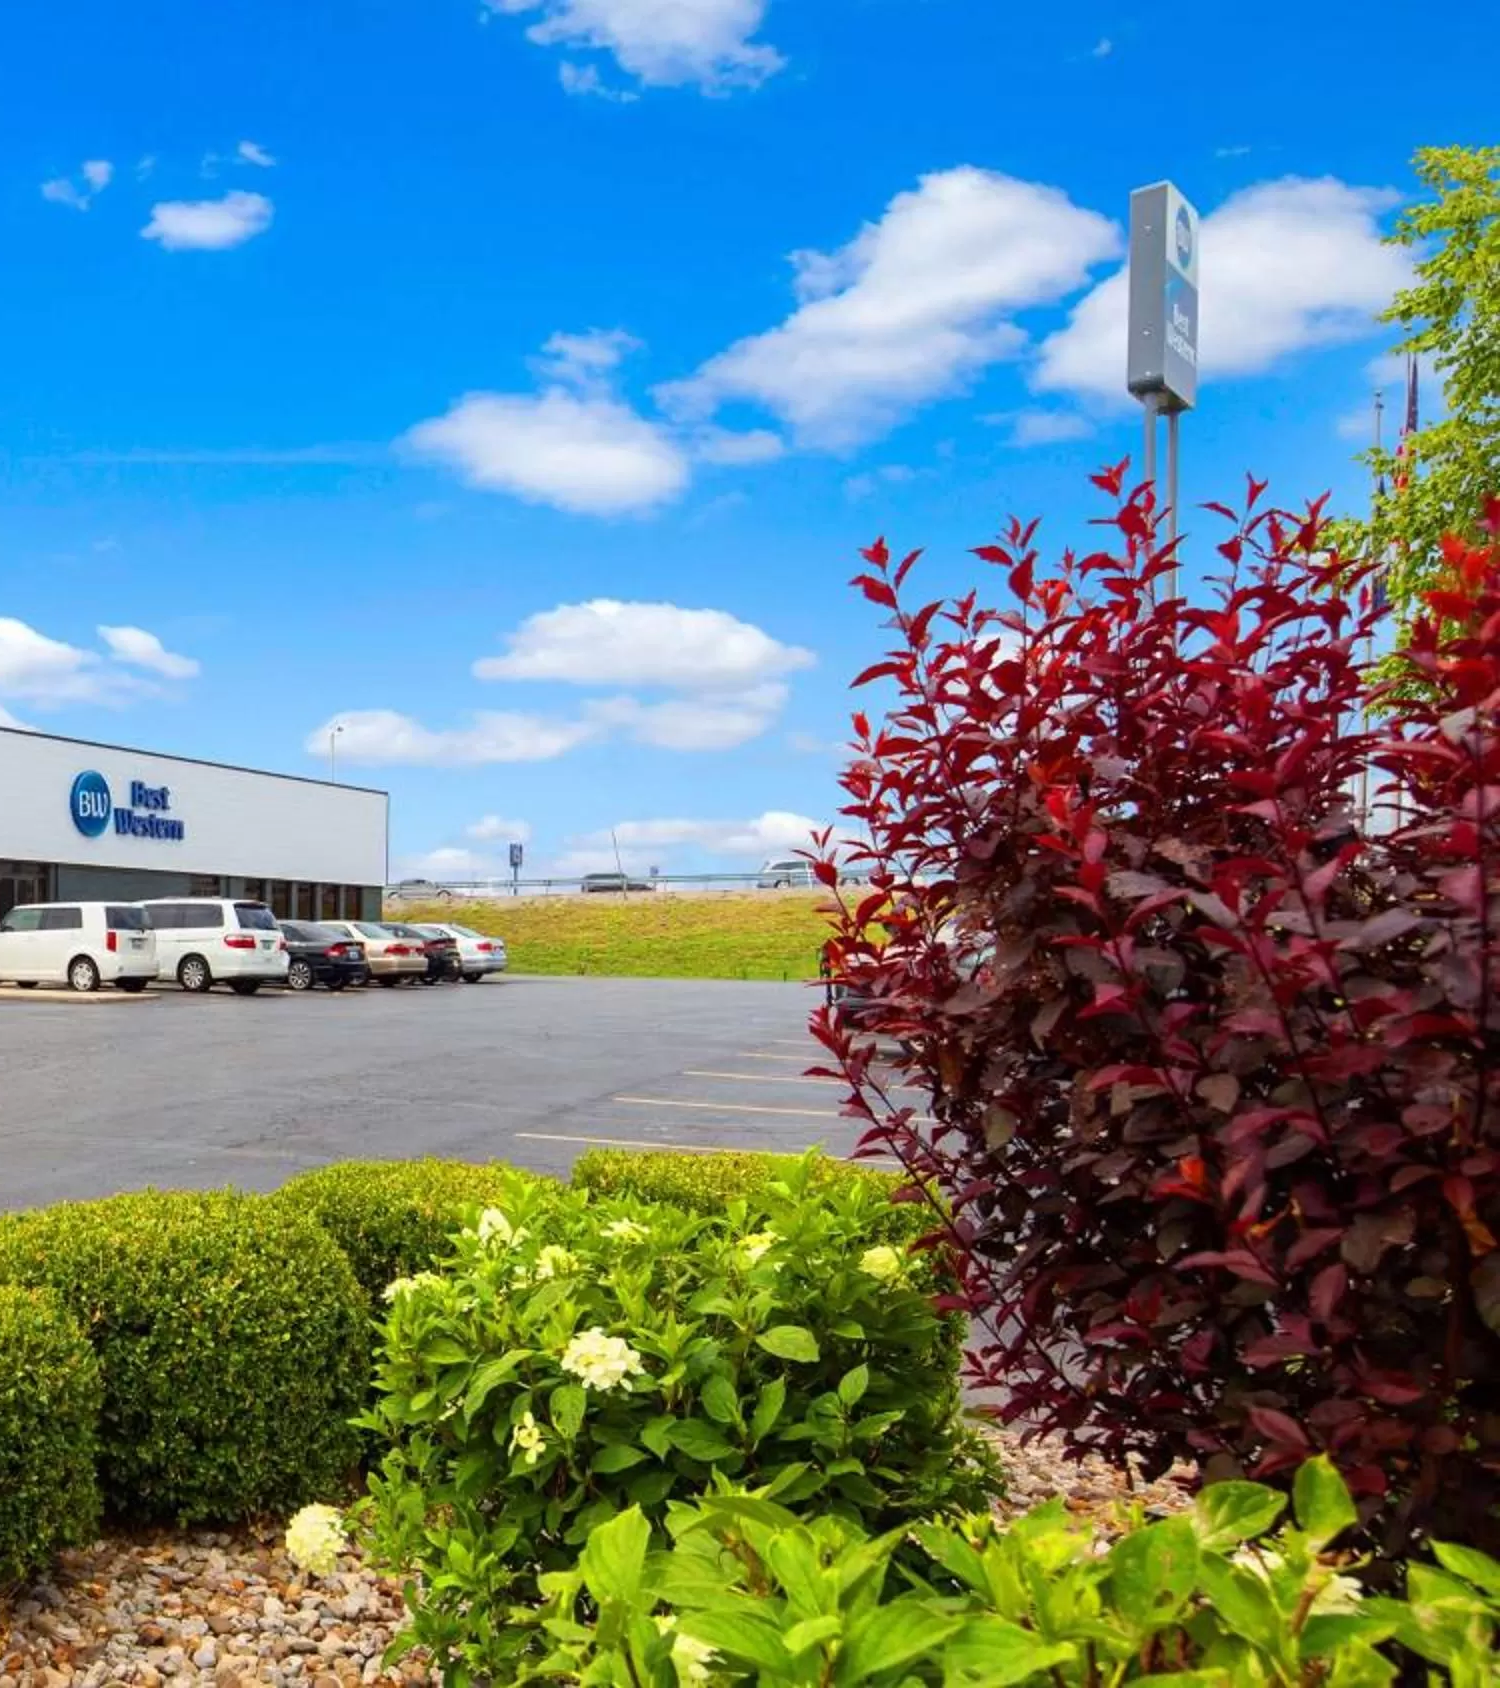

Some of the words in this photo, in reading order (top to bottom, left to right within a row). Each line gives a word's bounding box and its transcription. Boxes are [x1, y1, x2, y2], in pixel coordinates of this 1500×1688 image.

[79, 791, 107, 818] BW
[131, 780, 170, 810] Best
[114, 807, 184, 840] Western
